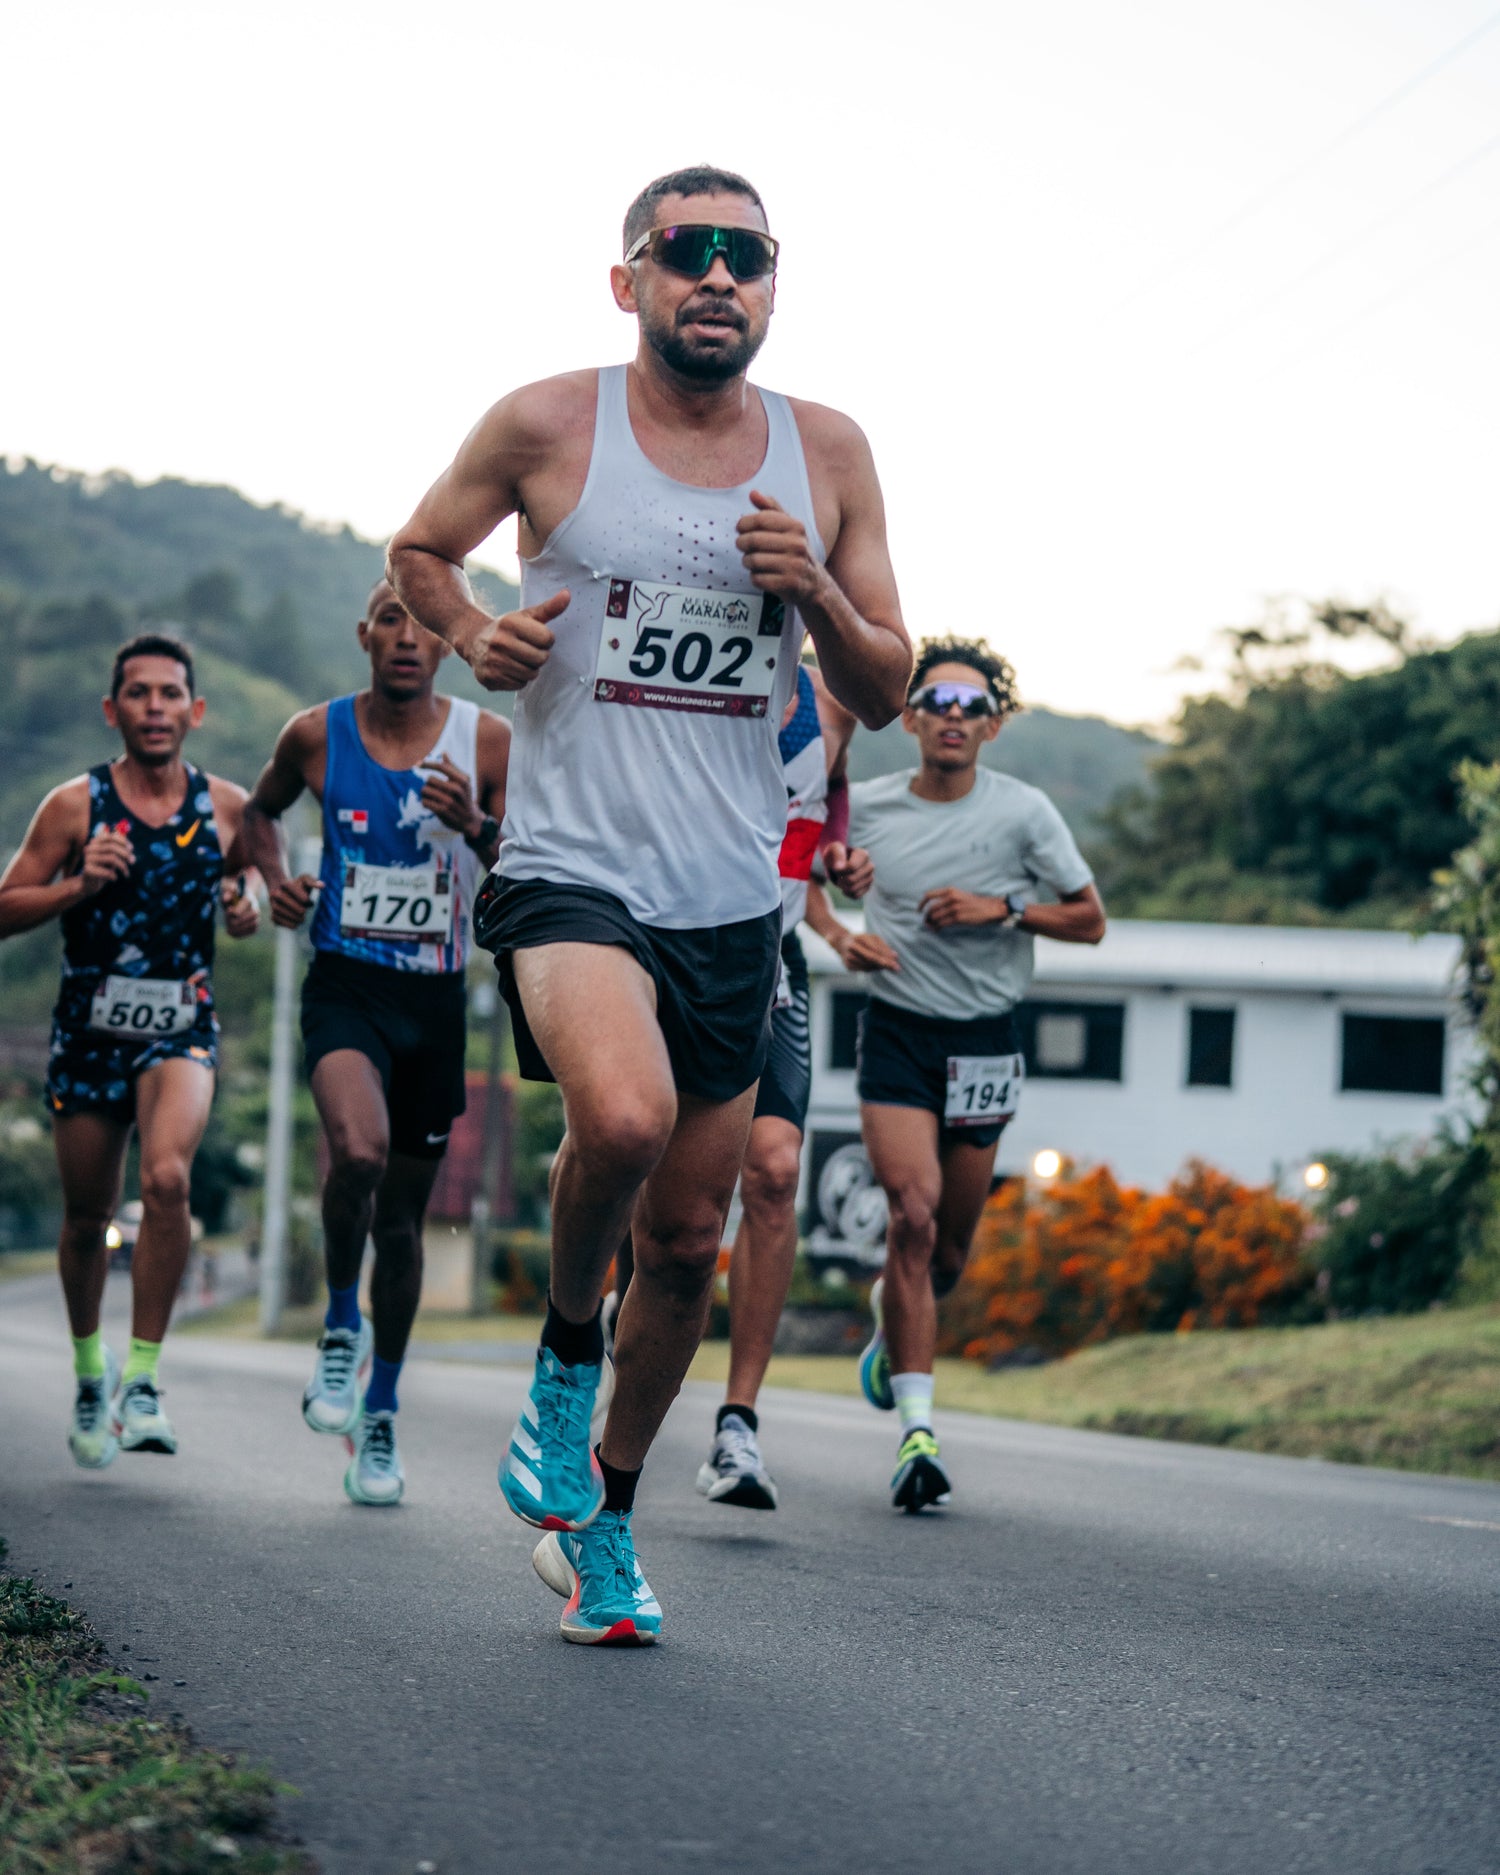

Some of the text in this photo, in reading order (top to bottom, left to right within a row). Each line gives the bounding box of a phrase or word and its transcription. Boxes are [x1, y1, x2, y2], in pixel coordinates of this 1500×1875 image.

[629, 626, 753, 687] 502
[362, 894, 432, 926] 170
[107, 1002, 177, 1031] 503
[963, 1081, 1010, 1111] 194
